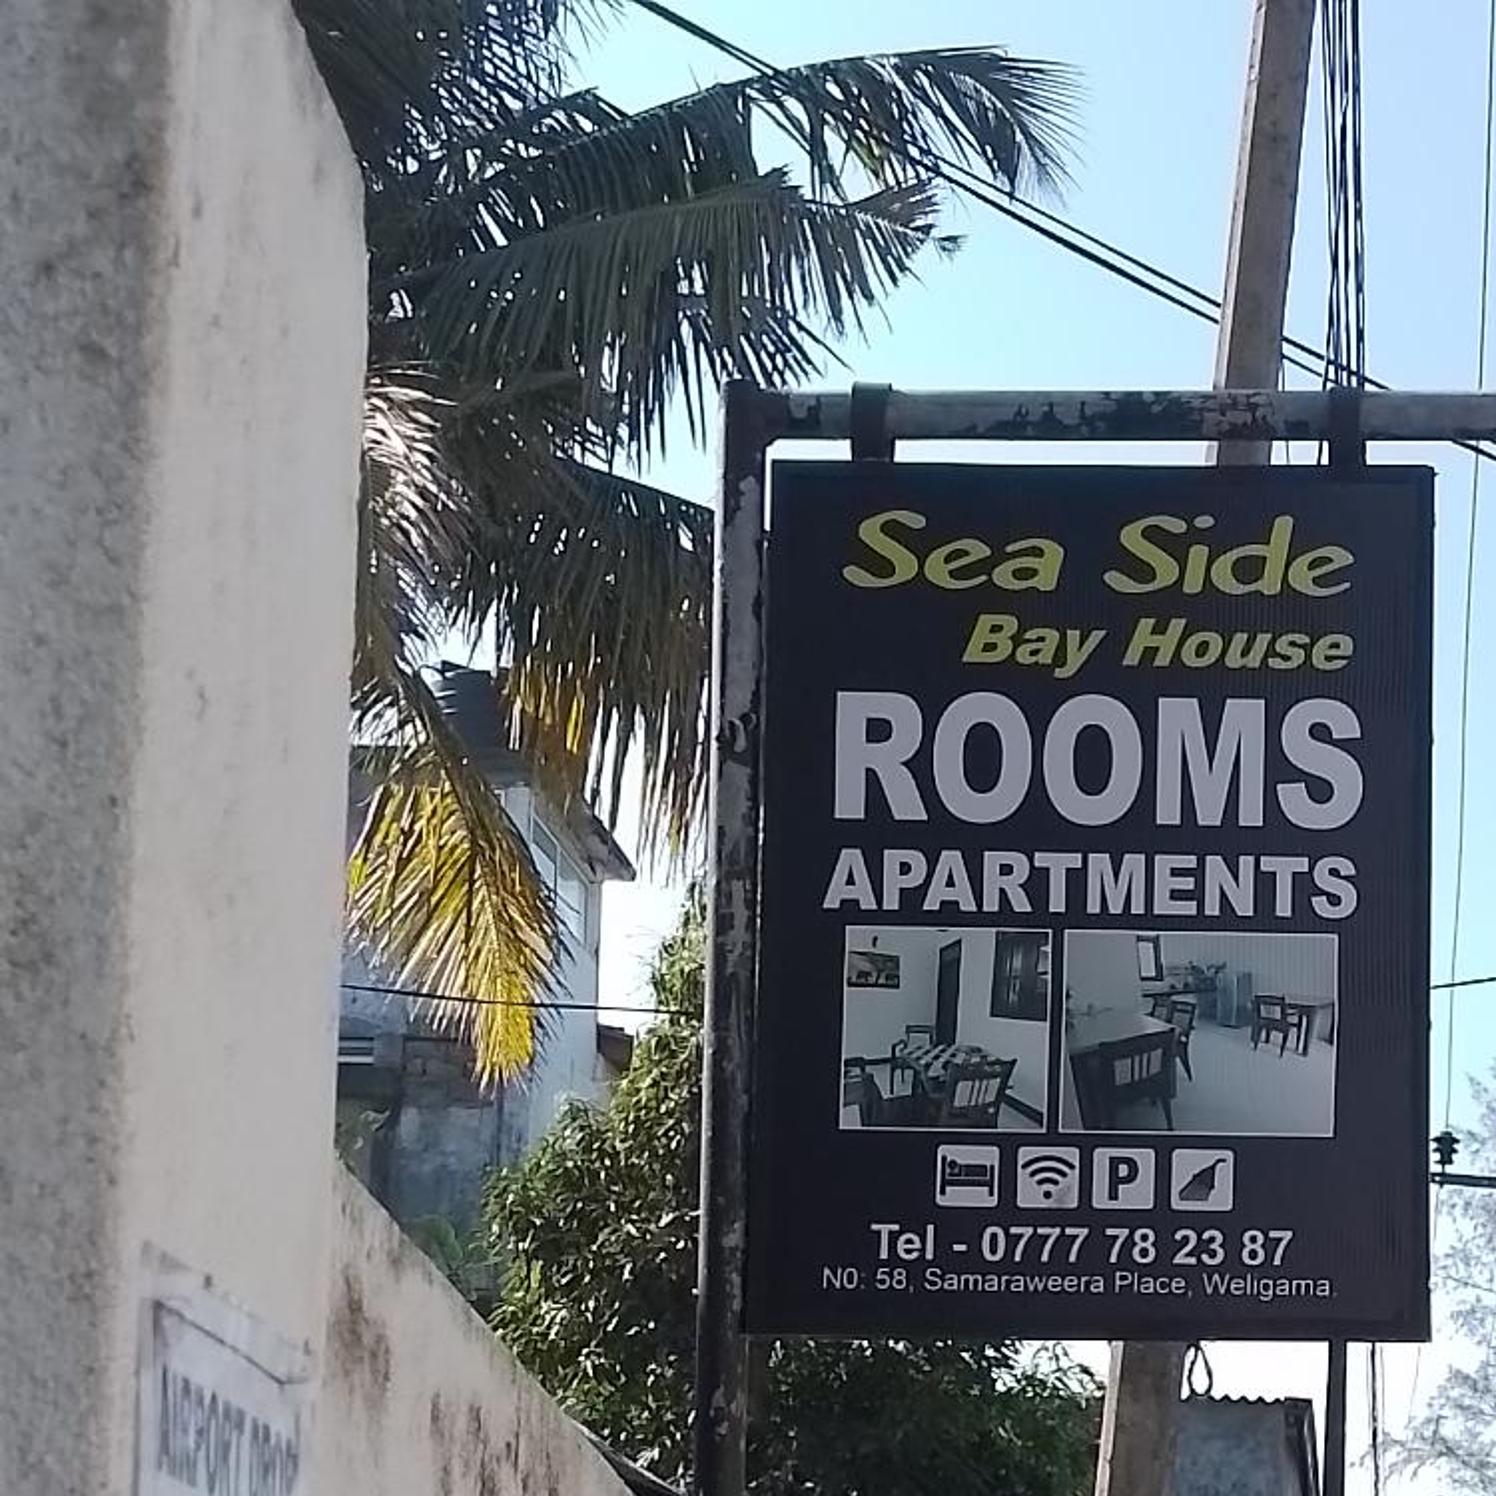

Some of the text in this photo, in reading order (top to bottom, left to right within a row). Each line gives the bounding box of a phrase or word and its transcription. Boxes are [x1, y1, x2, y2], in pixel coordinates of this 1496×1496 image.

[842, 510, 1355, 597] Sea Side
[962, 614, 1354, 678] Bay House
[833, 691, 1364, 830] ROOMS
[822, 848, 1358, 920] APARTMENTS
[870, 1223, 935, 1260] Tel
[981, 1226, 1090, 1263] 0777
[1104, 1227, 1157, 1264] 78
[1172, 1229, 1226, 1266] 23
[1241, 1230, 1294, 1266] 87
[924, 1268, 1104, 1294] Samaraweera
[1114, 1271, 1193, 1298] Place,
